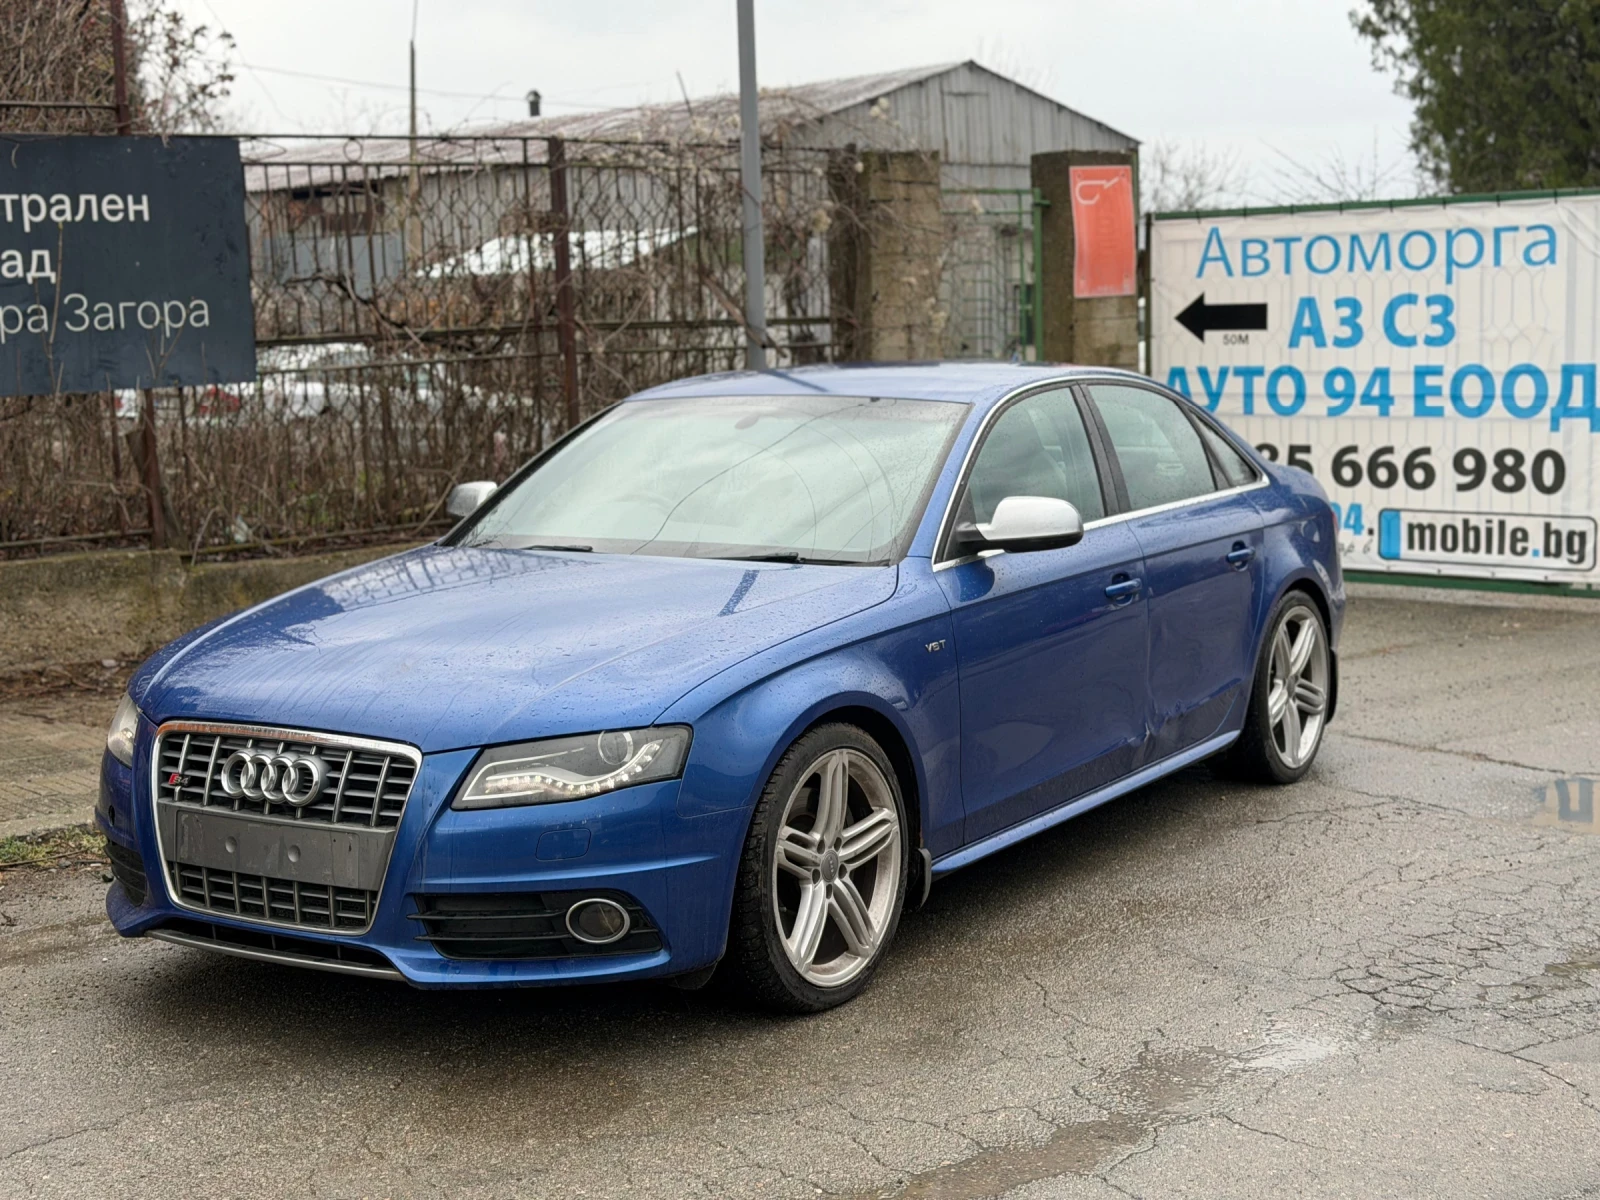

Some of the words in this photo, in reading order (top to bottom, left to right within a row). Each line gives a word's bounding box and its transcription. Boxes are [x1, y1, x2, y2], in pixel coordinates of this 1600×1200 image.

[1196, 222, 1557, 286] Автоморга
[63, 292, 209, 338] Загора
[1166, 364, 1306, 417] АУТО
[1323, 366, 1395, 417] 94
[1413, 363, 1600, 433] ЕООД
[1331, 444, 1436, 490] 666
[1452, 447, 1566, 495] 980
[1407, 518, 1587, 565] mobile.bg
